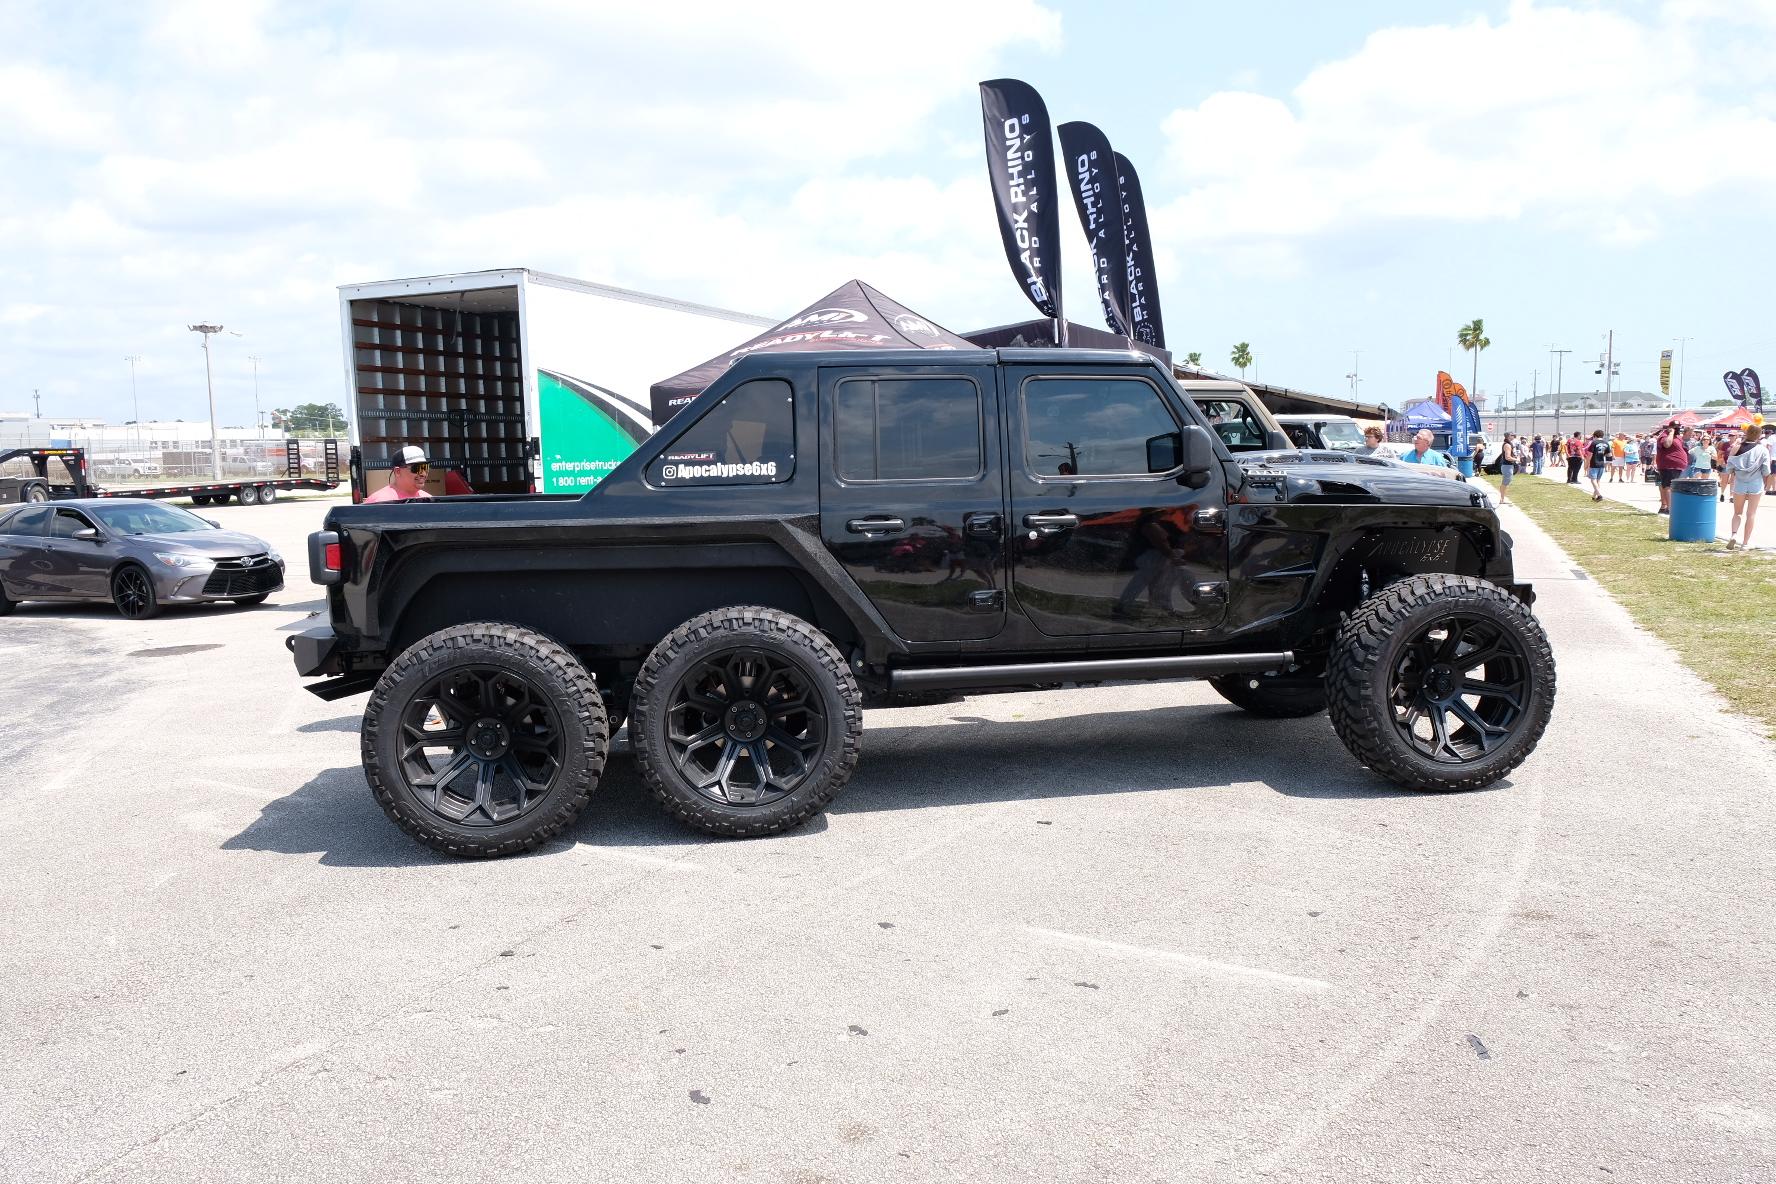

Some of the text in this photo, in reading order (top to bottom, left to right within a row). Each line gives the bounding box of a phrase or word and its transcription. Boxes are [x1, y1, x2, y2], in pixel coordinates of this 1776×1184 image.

[1004, 117, 1027, 203] RHINO
[1022, 113, 1038, 213] ALLOYS
[1091, 150, 1106, 238] ALLOYS
[1119, 175, 1138, 251] ALLOYS
[1126, 251, 1143, 323] BLACK
[1135, 267, 1149, 319] HARD
[729, 330, 891, 357] READYLIFT
[558, 477, 574, 487] 800
[667, 452, 714, 460] READYLIFT
[677, 461, 777, 479] Apocalypse6x6
